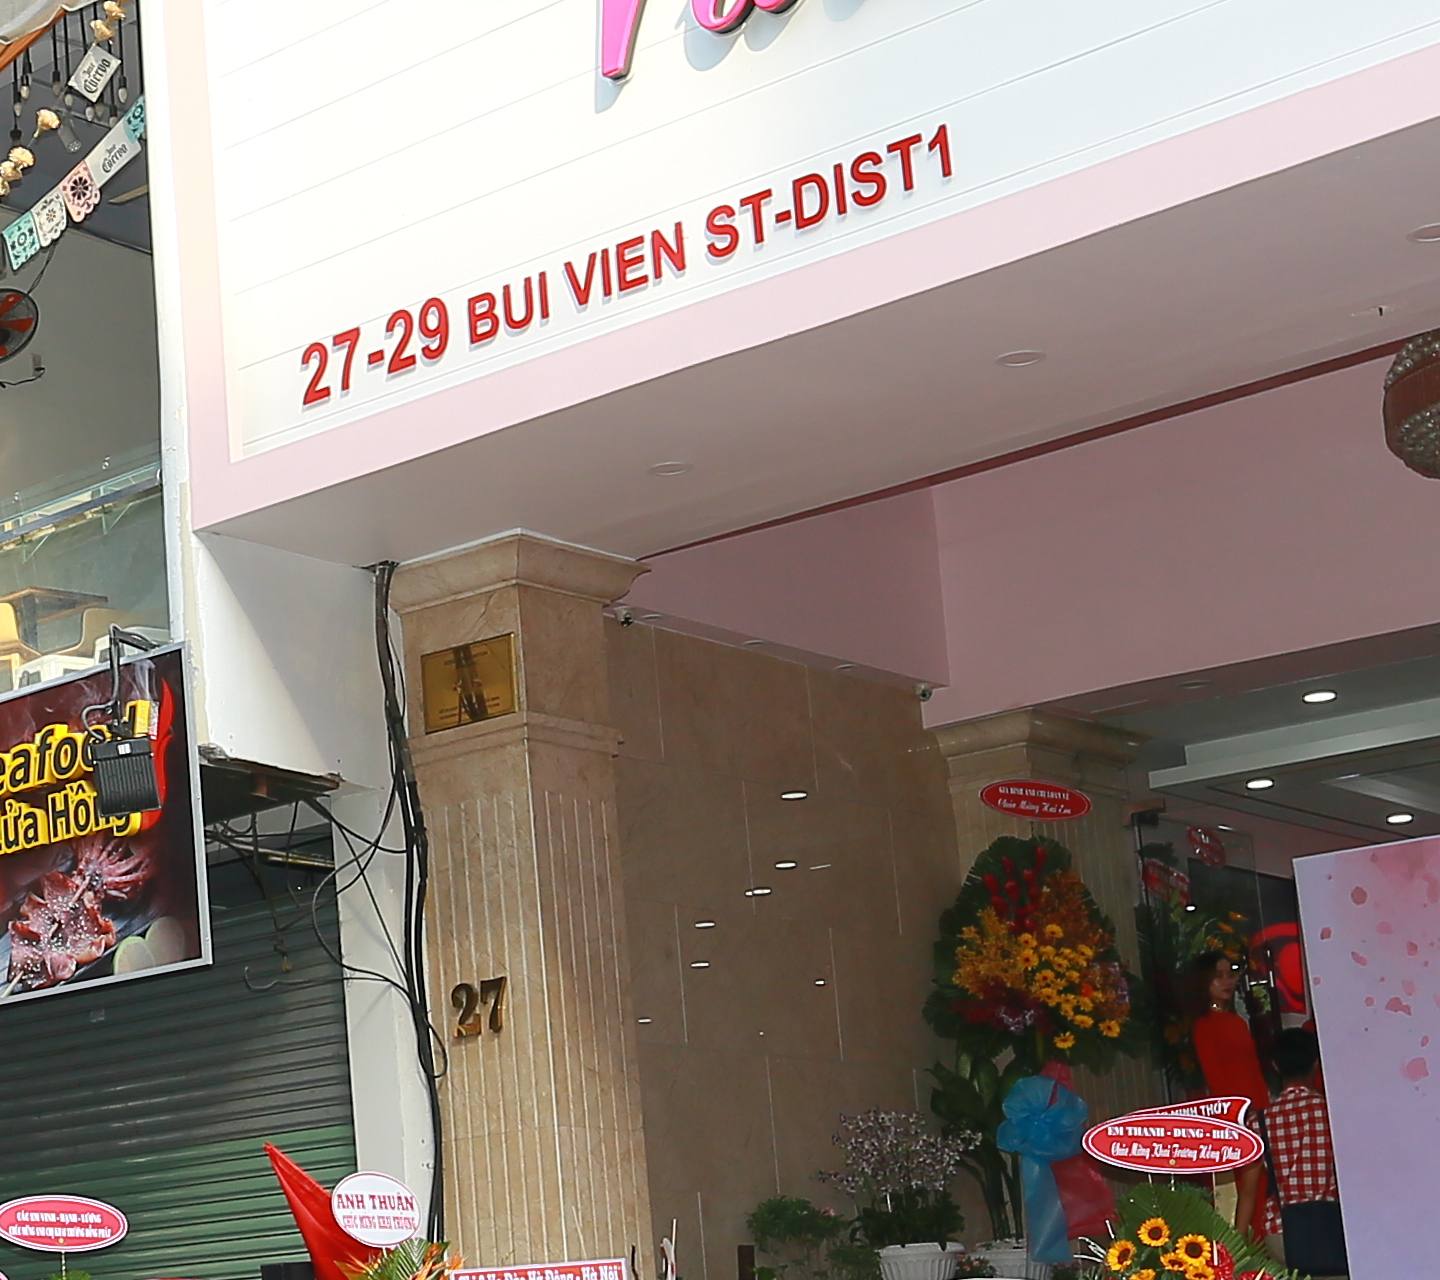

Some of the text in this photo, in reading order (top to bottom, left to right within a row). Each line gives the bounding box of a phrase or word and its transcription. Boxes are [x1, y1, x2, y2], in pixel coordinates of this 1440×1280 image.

[301, 296, 450, 406] 27-29
[467, 270, 551, 346] BUI
[563, 221, 687, 308] VIEN
[450, 976, 508, 1038] 27
[1107, 1126, 1124, 1137] EM
[1126, 1126, 1165, 1138] THANH
[336, 1193, 366, 1210] ANH
